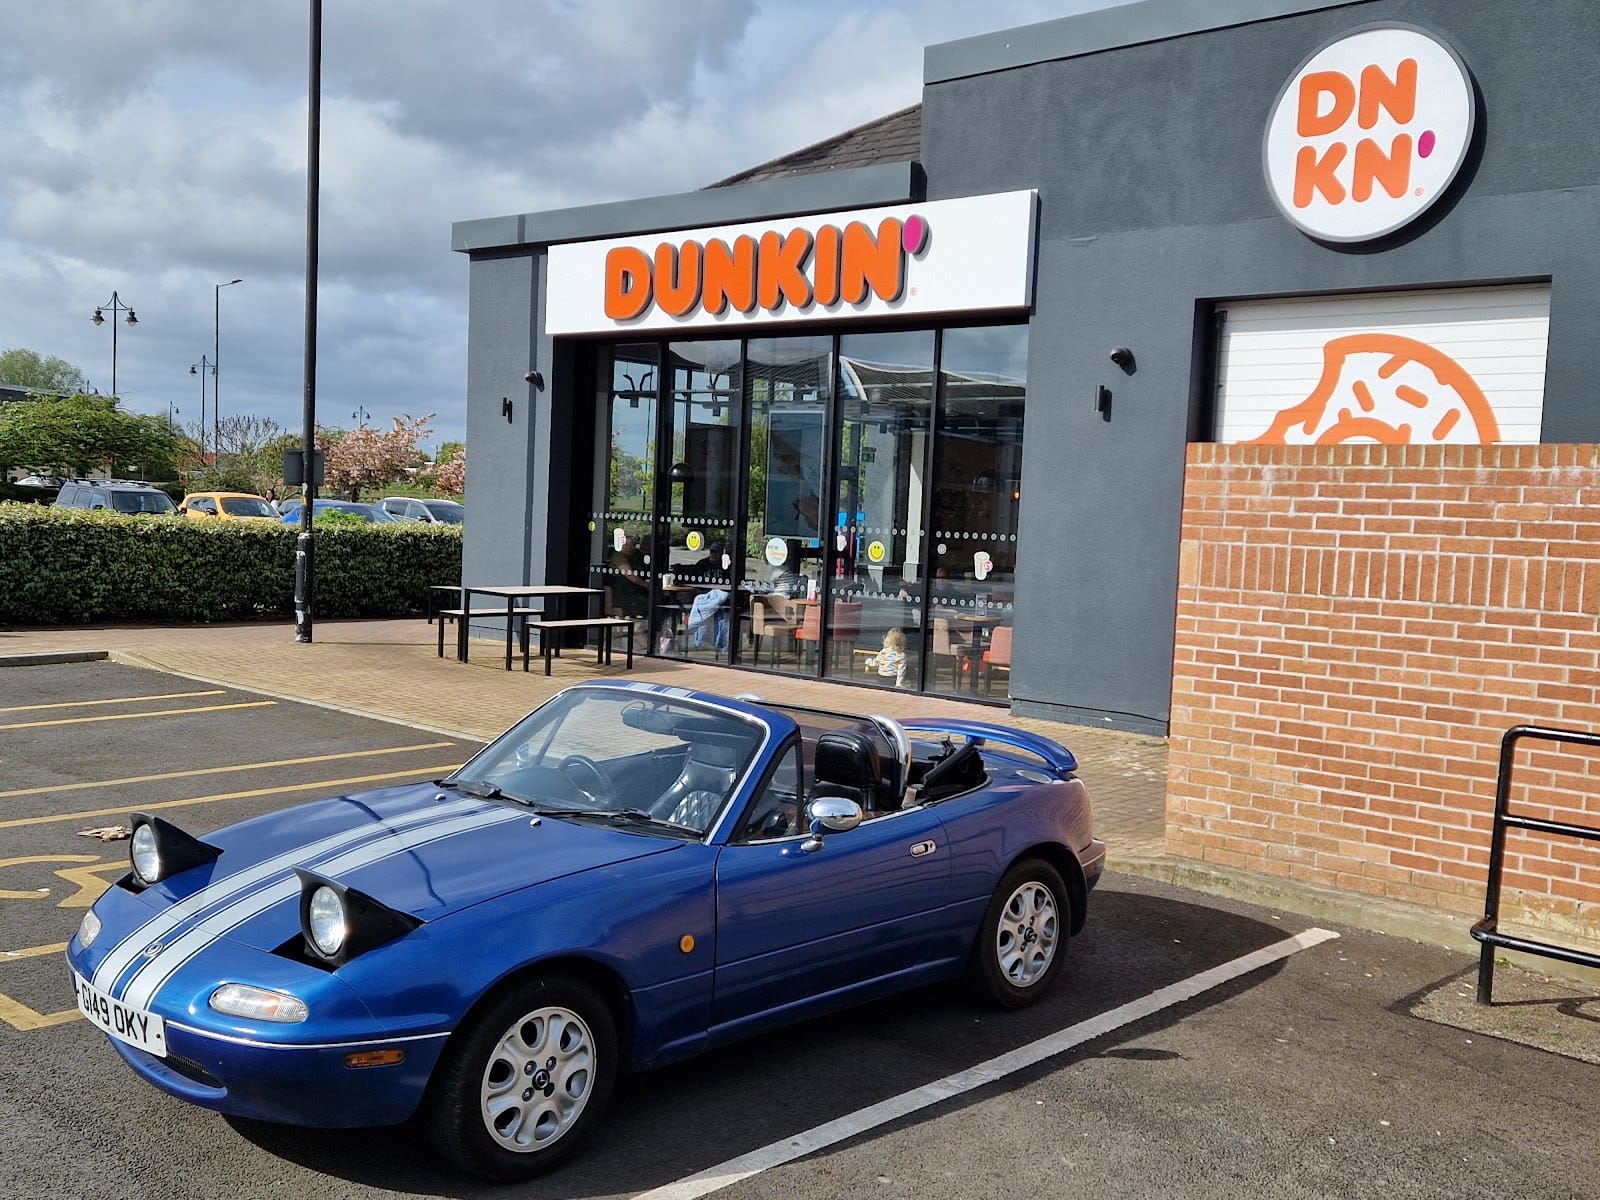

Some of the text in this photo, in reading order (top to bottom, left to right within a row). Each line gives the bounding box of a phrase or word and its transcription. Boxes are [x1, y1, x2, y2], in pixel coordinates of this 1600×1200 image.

[1297, 58, 1418, 137] DN
[604, 214, 927, 320] DUNKIN'
[81, 983, 148, 1043] G149 OKY
